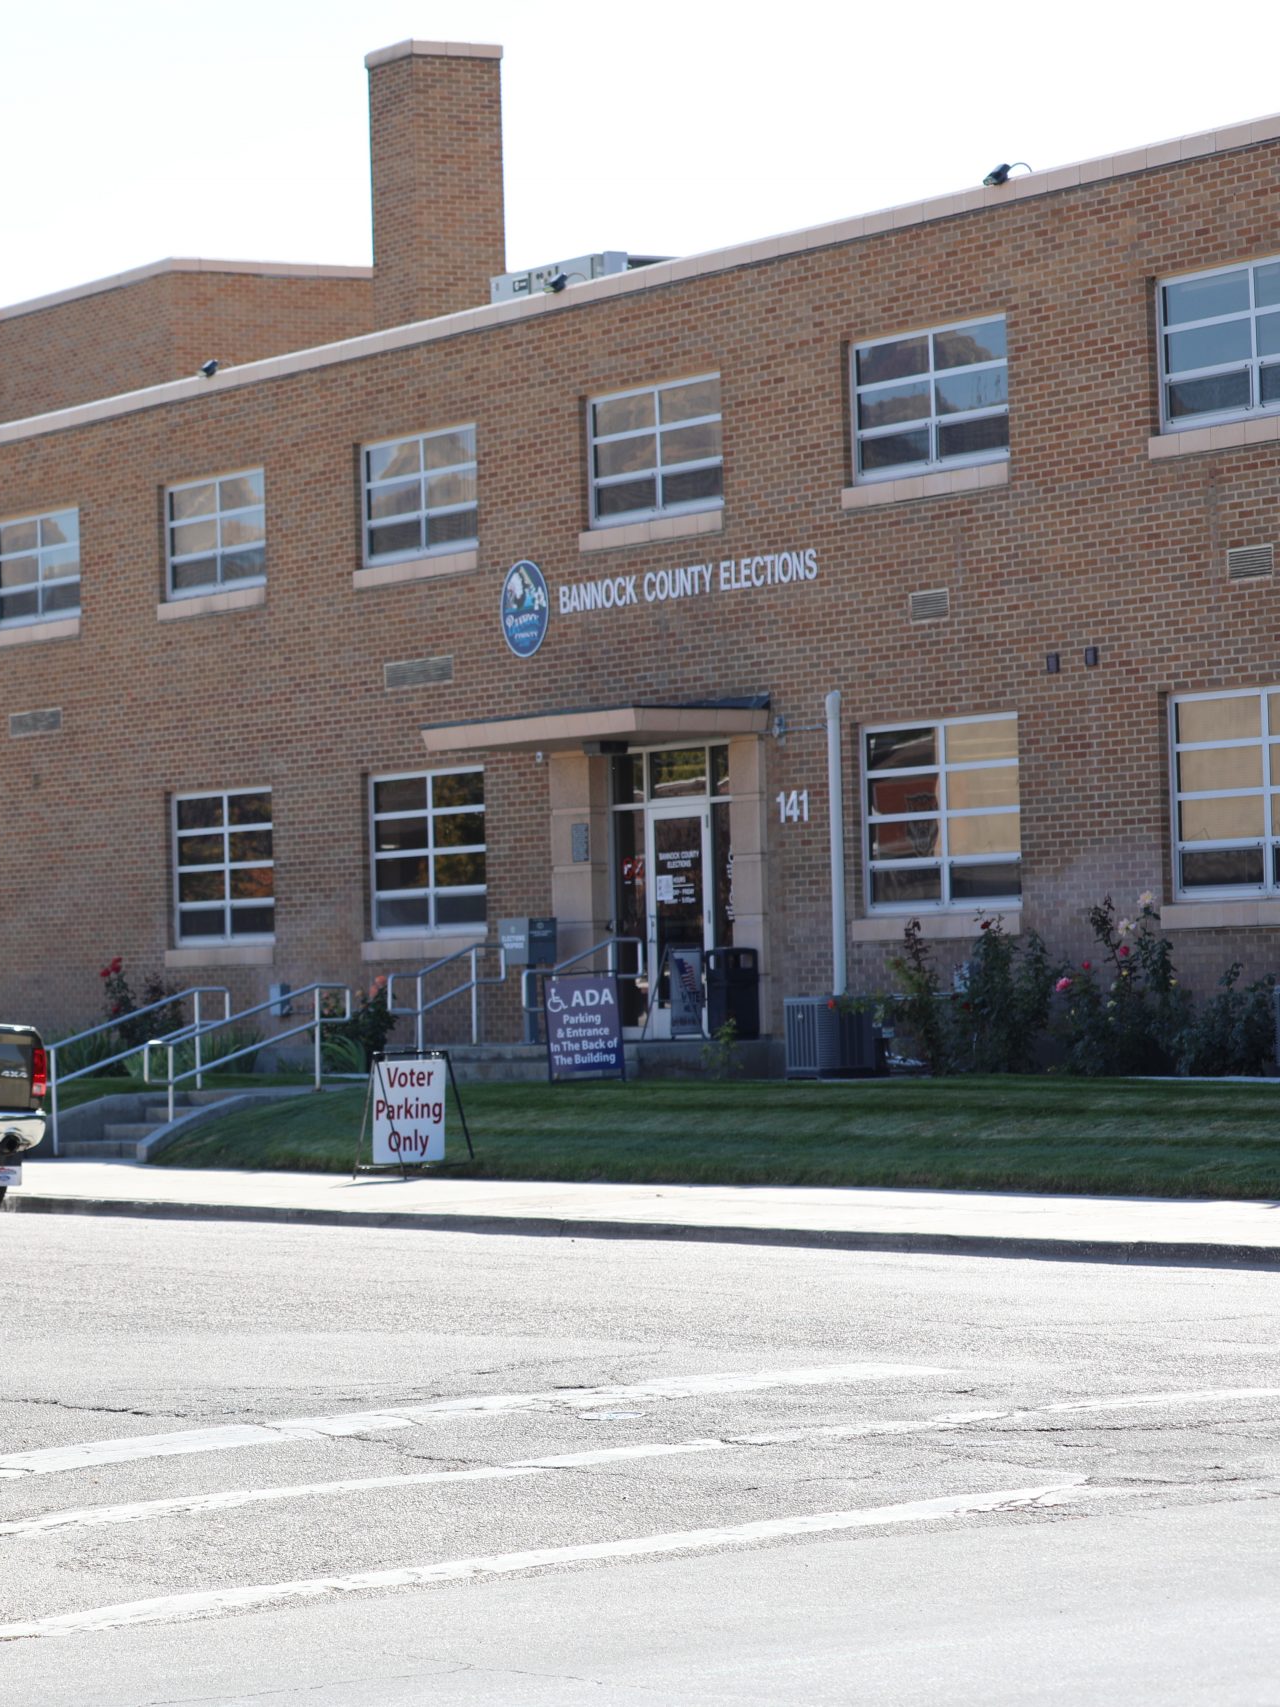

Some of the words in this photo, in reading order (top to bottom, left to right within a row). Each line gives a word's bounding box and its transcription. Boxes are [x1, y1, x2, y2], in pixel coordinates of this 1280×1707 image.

[559, 576, 637, 615] BANNOCK
[644, 563, 713, 601] COUNTY
[719, 549, 818, 592] ELECTIONS
[776, 789, 809, 824] 141
[571, 988, 615, 1008] ADA
[562, 1013, 602, 1025] Parking
[556, 1028, 565, 1039] &
[566, 1027, 610, 1038] Entrance
[550, 1042, 560, 1053] In
[561, 1041, 580, 1051] The
[581, 1039, 606, 1051] Back
[607, 1037, 618, 1049] of
[553, 1055, 573, 1066] The
[574, 1052, 616, 1065] Building
[386, 1067, 434, 1088] Voter
[375, 1097, 443, 1124] Parking
[388, 1129, 429, 1157] Only
